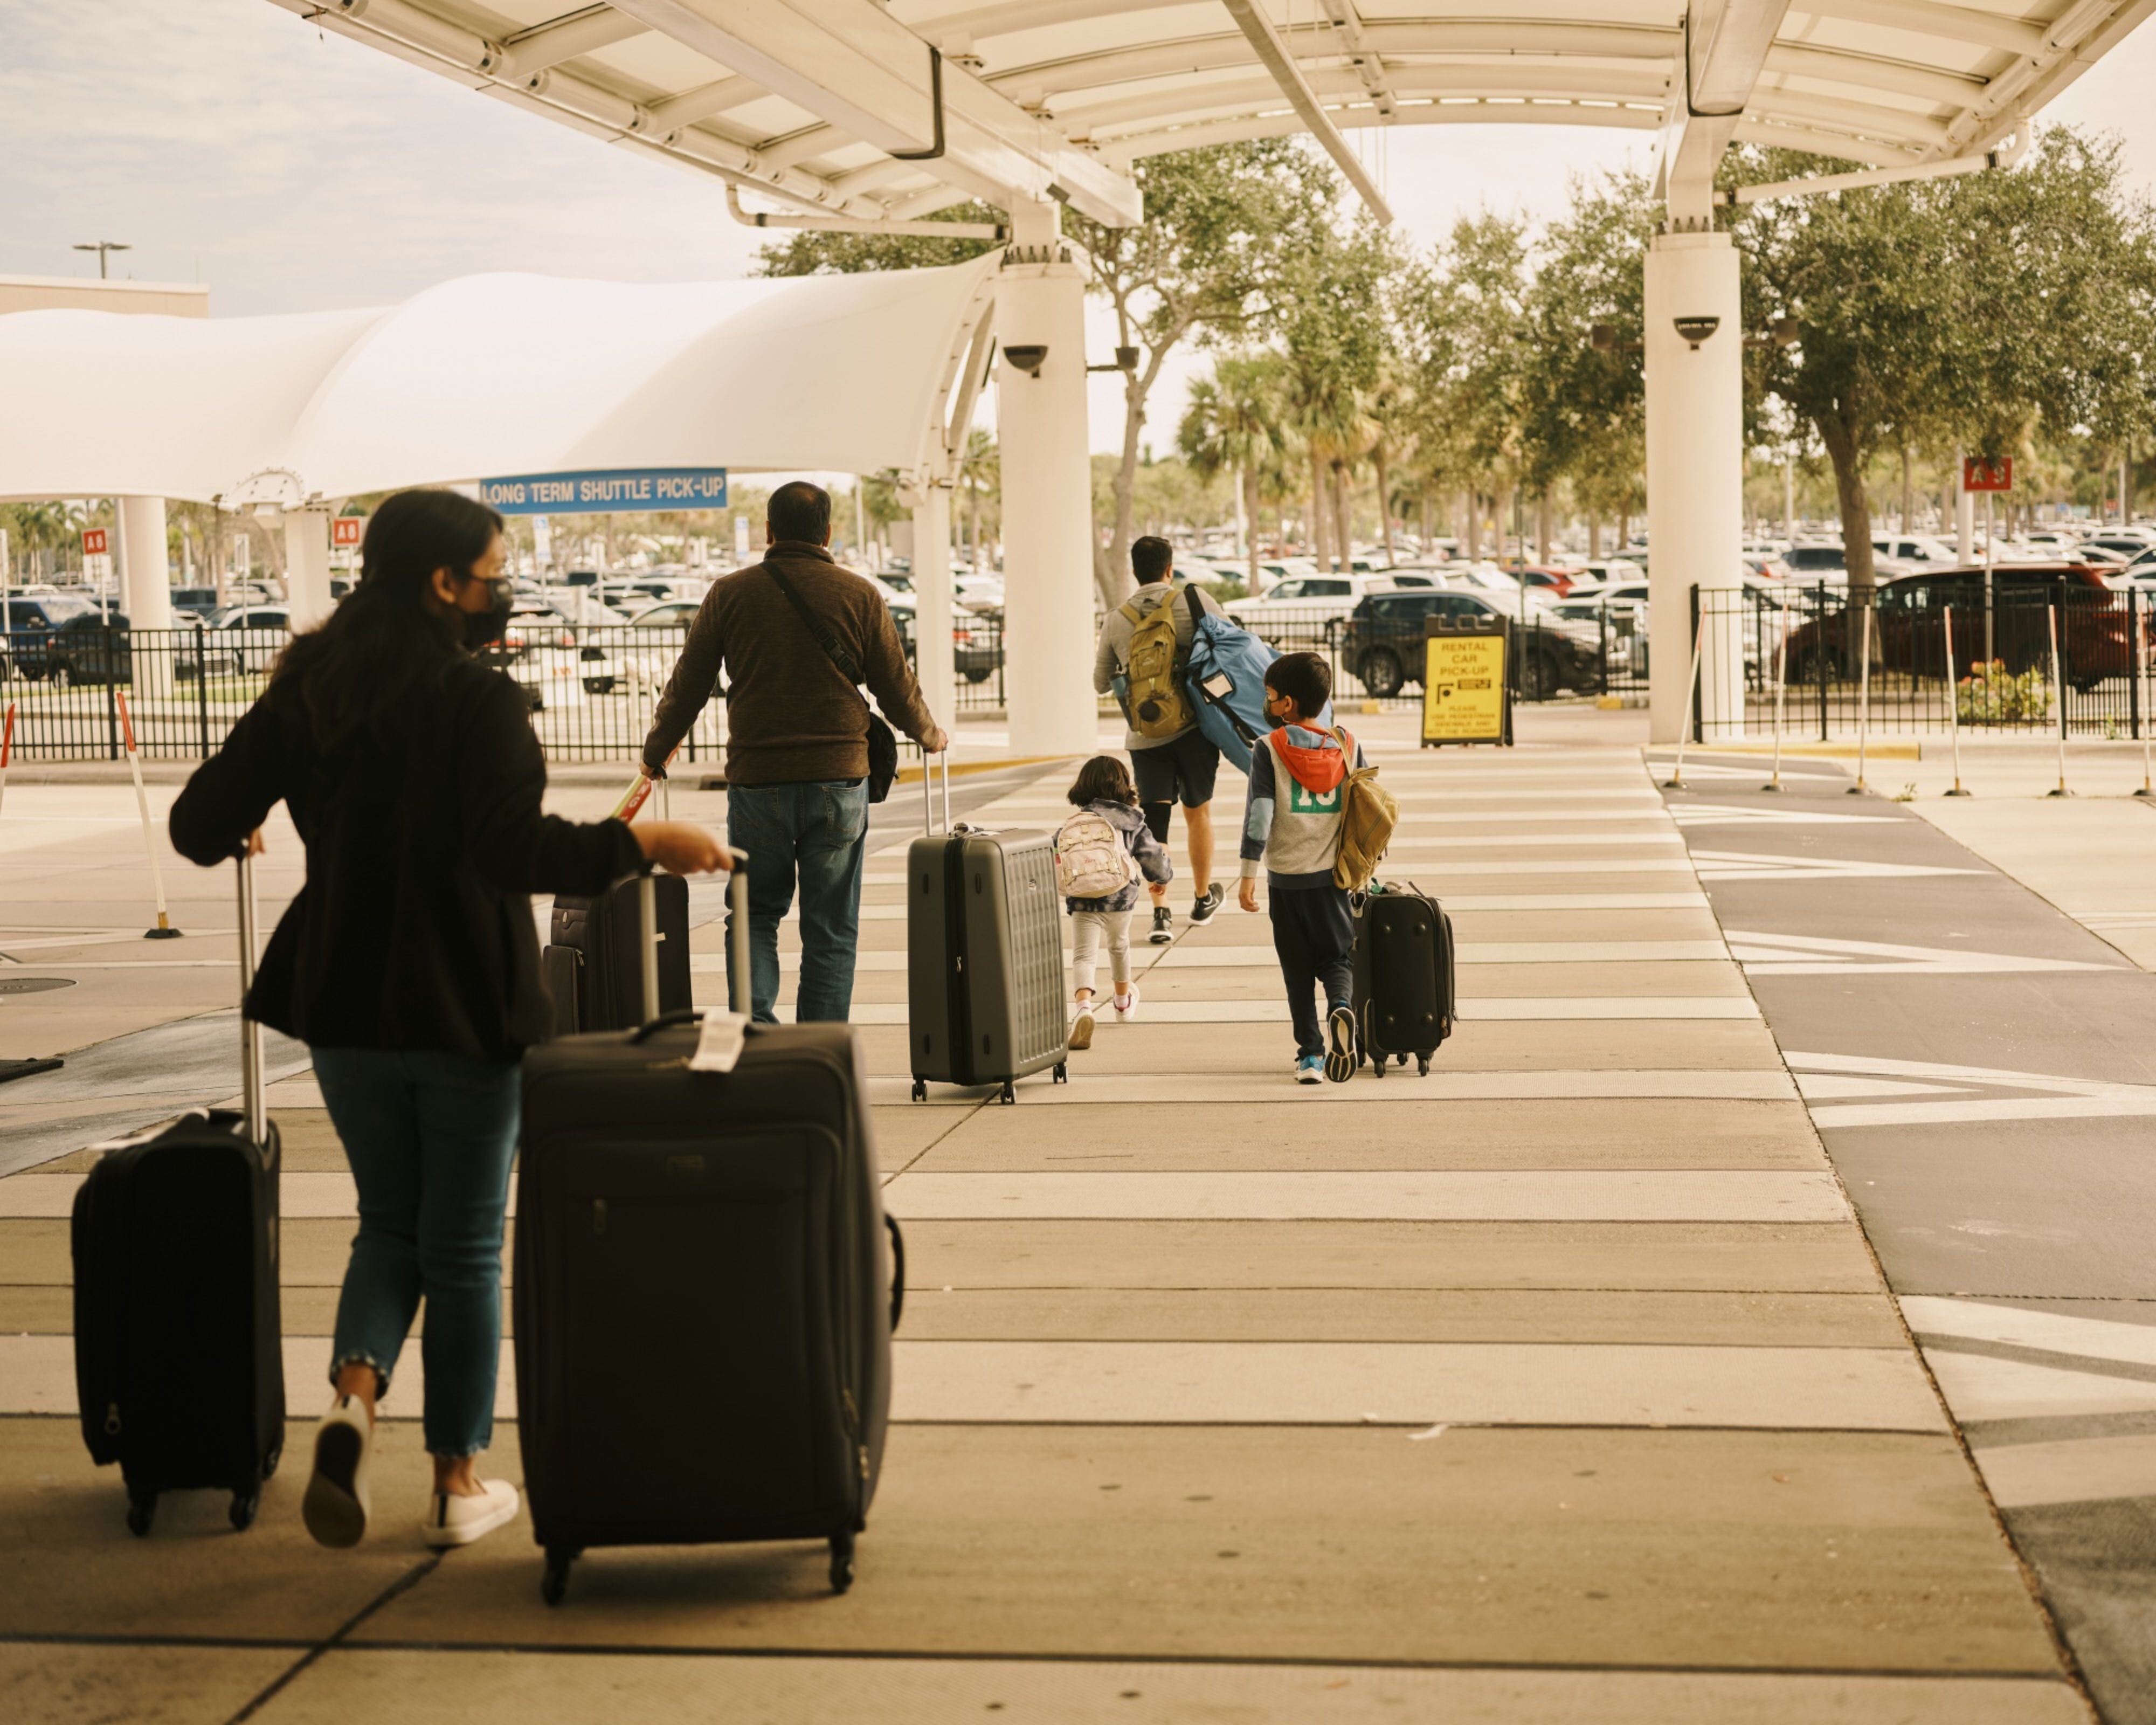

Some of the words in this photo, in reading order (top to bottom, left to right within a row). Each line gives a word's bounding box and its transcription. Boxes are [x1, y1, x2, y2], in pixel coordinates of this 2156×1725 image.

[482, 484, 525, 505] LONG
[530, 481, 574, 503] TERM
[580, 479, 651, 501] SHUTTLE
[657, 476, 724, 499] PICK-UP
[1441, 641, 1489, 652] RENTAL
[1451, 654, 1477, 664] CAR
[1440, 665, 1489, 677] PICK-UP
